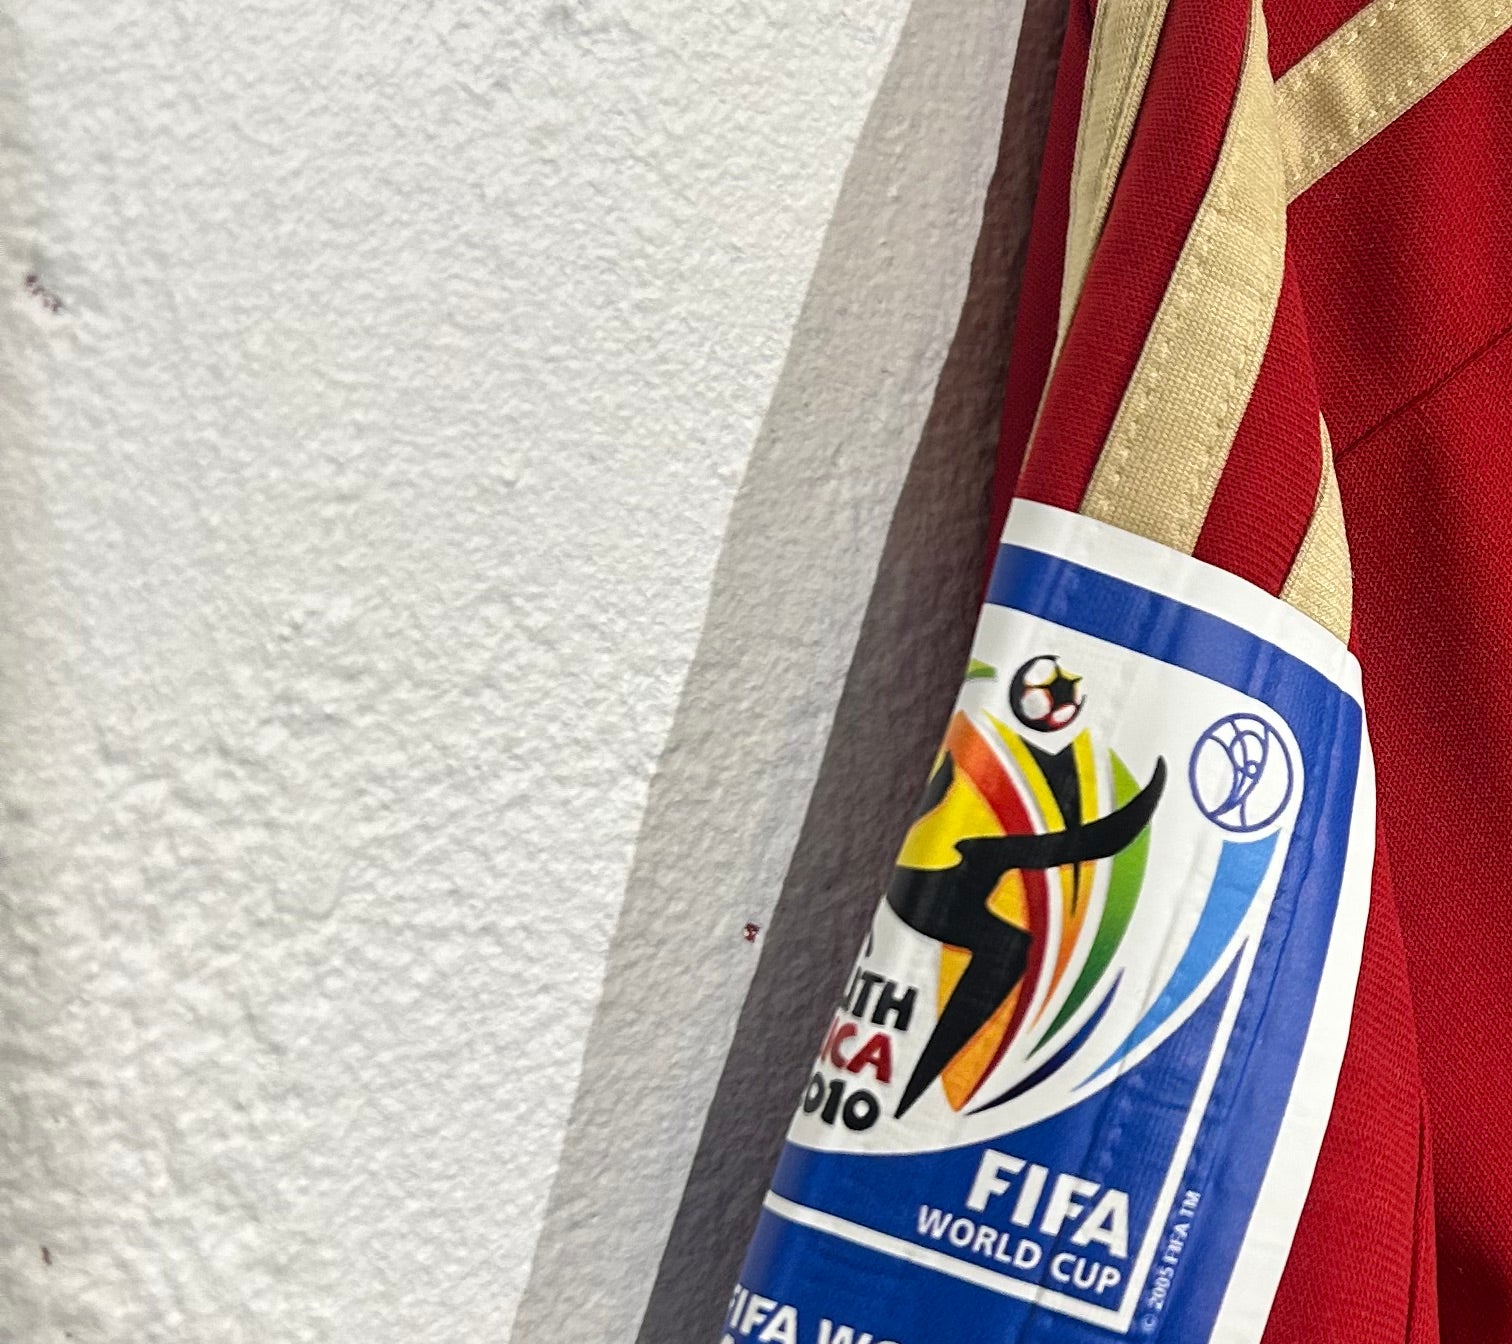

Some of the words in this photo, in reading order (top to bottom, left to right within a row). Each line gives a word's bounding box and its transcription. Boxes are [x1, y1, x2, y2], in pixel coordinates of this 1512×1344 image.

[917, 1203, 1043, 1271] WORLD
[1050, 1251, 1122, 1294] CUP
[965, 1147, 1129, 1259] FIFA
[1147, 1265, 1175, 1313] 2005
[1161, 1221, 1191, 1265] FIFA
[1178, 1188, 1202, 1218] TM
